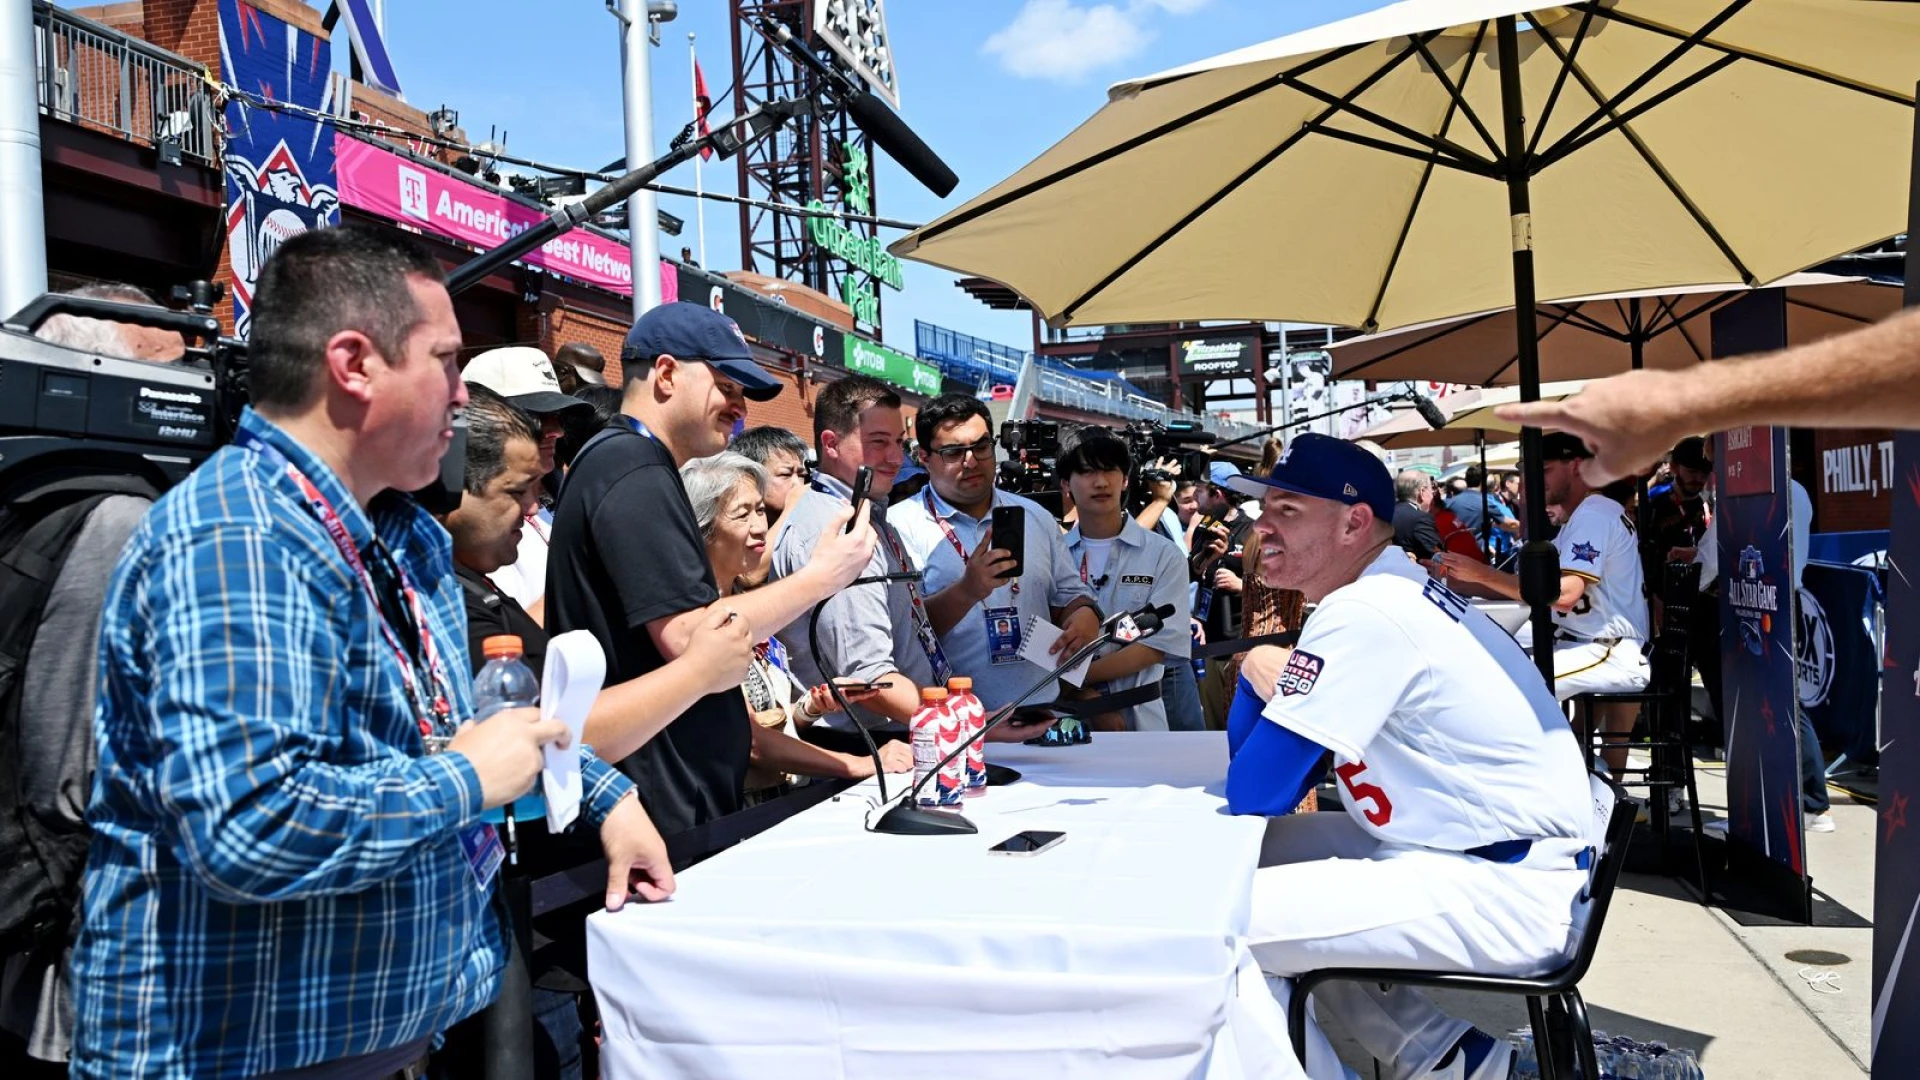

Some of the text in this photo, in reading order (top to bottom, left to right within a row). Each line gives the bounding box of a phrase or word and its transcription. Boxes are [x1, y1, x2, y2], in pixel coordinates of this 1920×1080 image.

[582, 243, 632, 282] Netwo
[869, 236, 904, 292] Bank
[843, 273, 881, 329] Park
[1194, 361, 1239, 371] ROOFTOP
[1823, 444, 1877, 497] PHILLY,
[1278, 672, 1313, 693] 250
[1290, 653, 1318, 674] USA
[1336, 760, 1393, 827] 5
